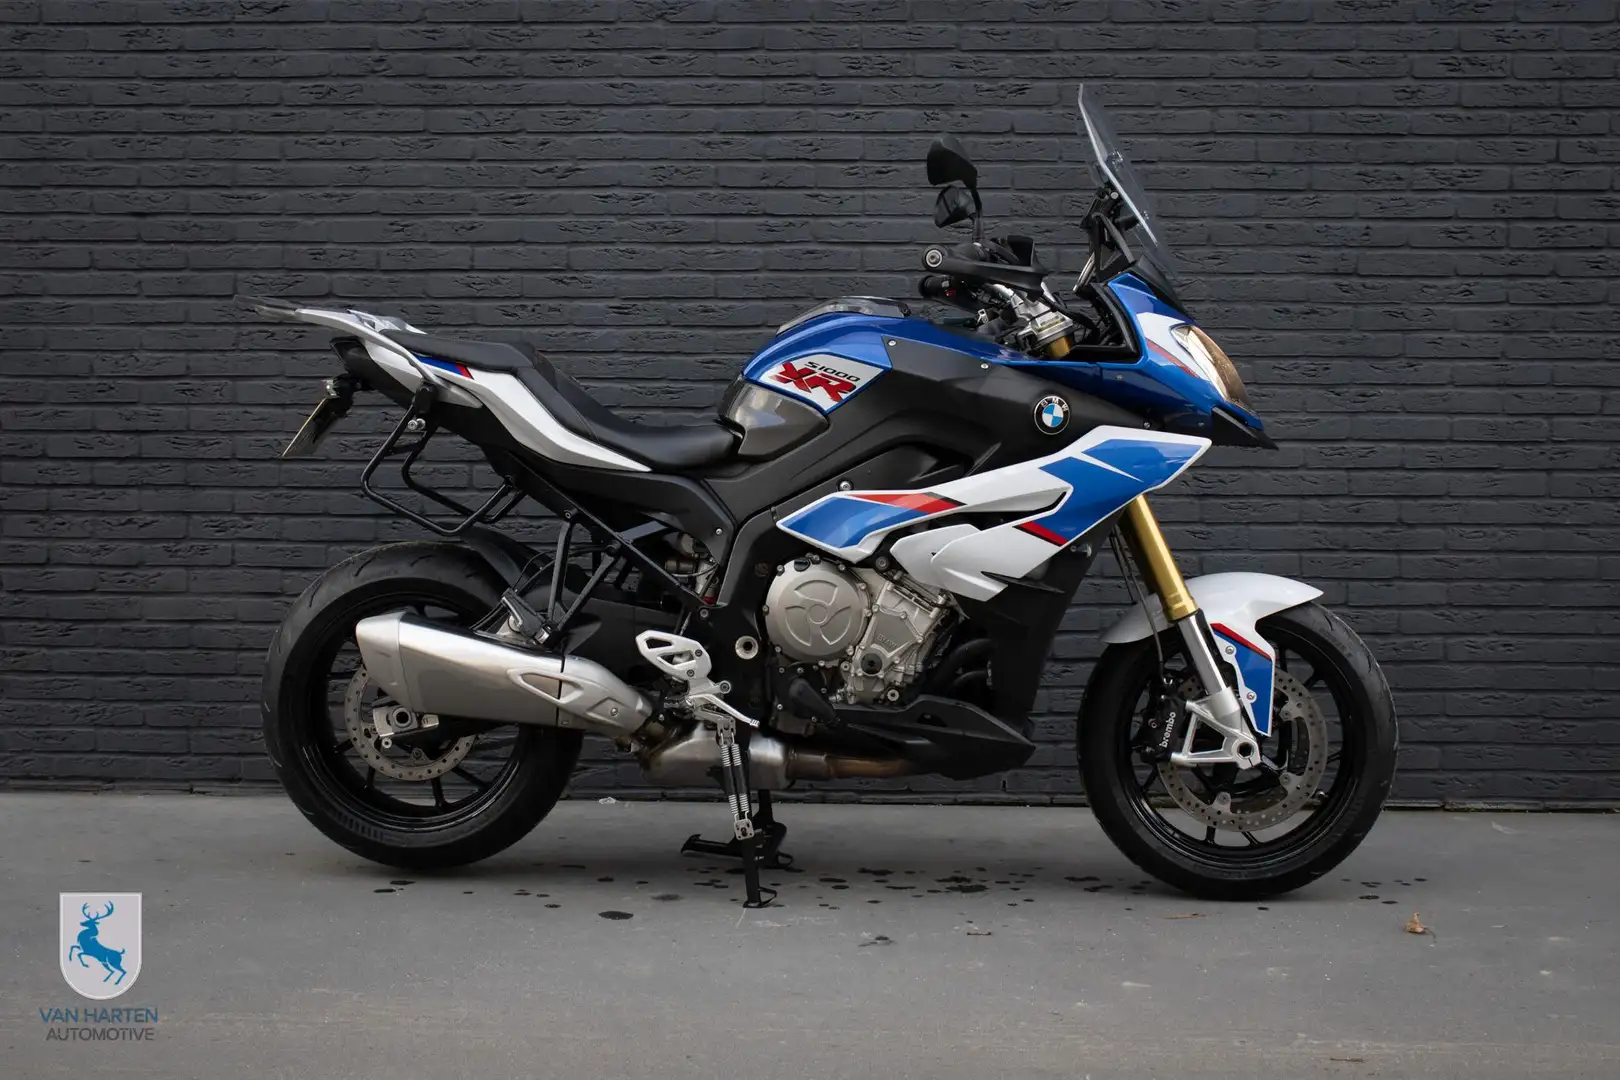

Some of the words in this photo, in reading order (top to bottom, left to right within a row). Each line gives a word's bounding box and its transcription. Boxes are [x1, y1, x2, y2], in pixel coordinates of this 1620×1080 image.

[771, 361, 857, 402] XR
[804, 361, 860, 382] S1000
[1040, 397, 1069, 411] BMW
[1159, 711, 1176, 748] brembo
